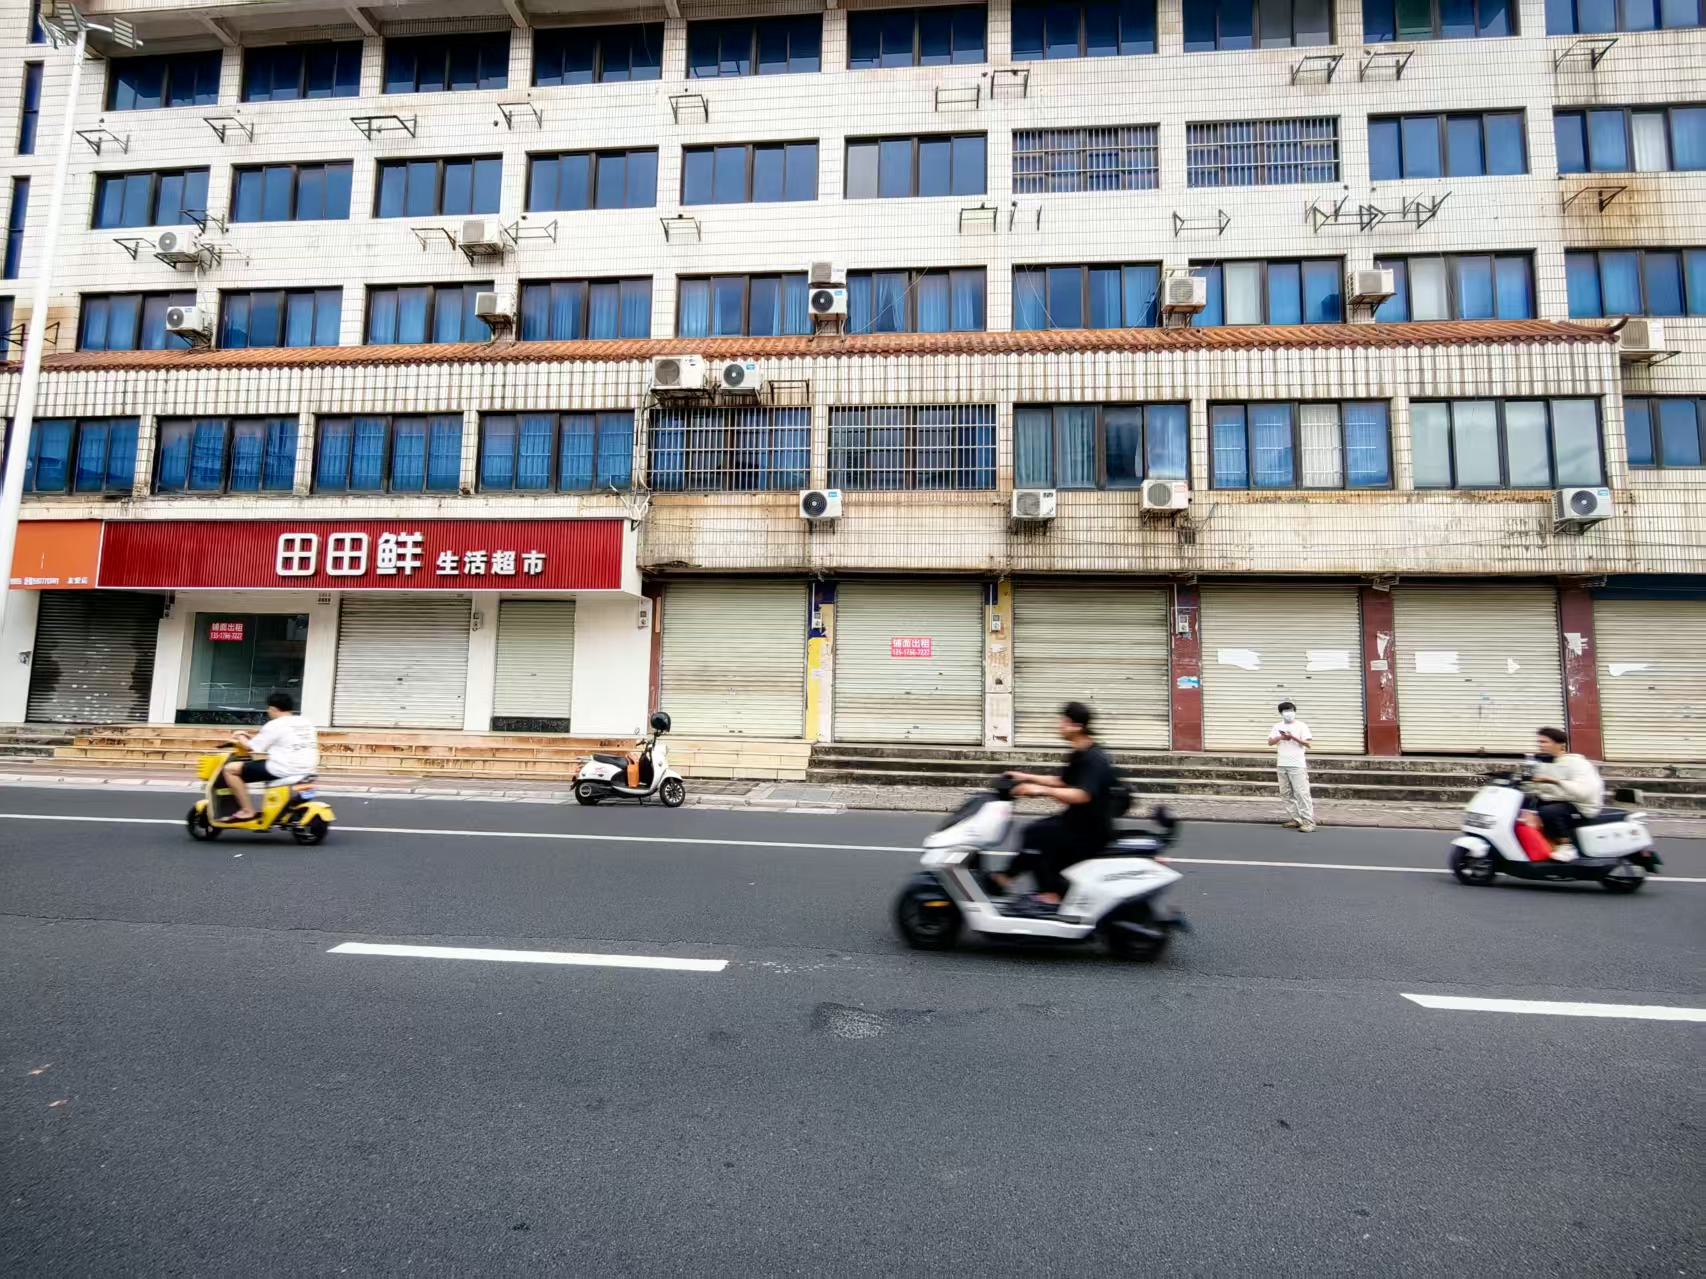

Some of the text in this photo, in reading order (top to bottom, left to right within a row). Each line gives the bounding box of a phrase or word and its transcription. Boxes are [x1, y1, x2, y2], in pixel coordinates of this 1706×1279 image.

[276, 532, 546, 576] 田田鲜 生活超市
